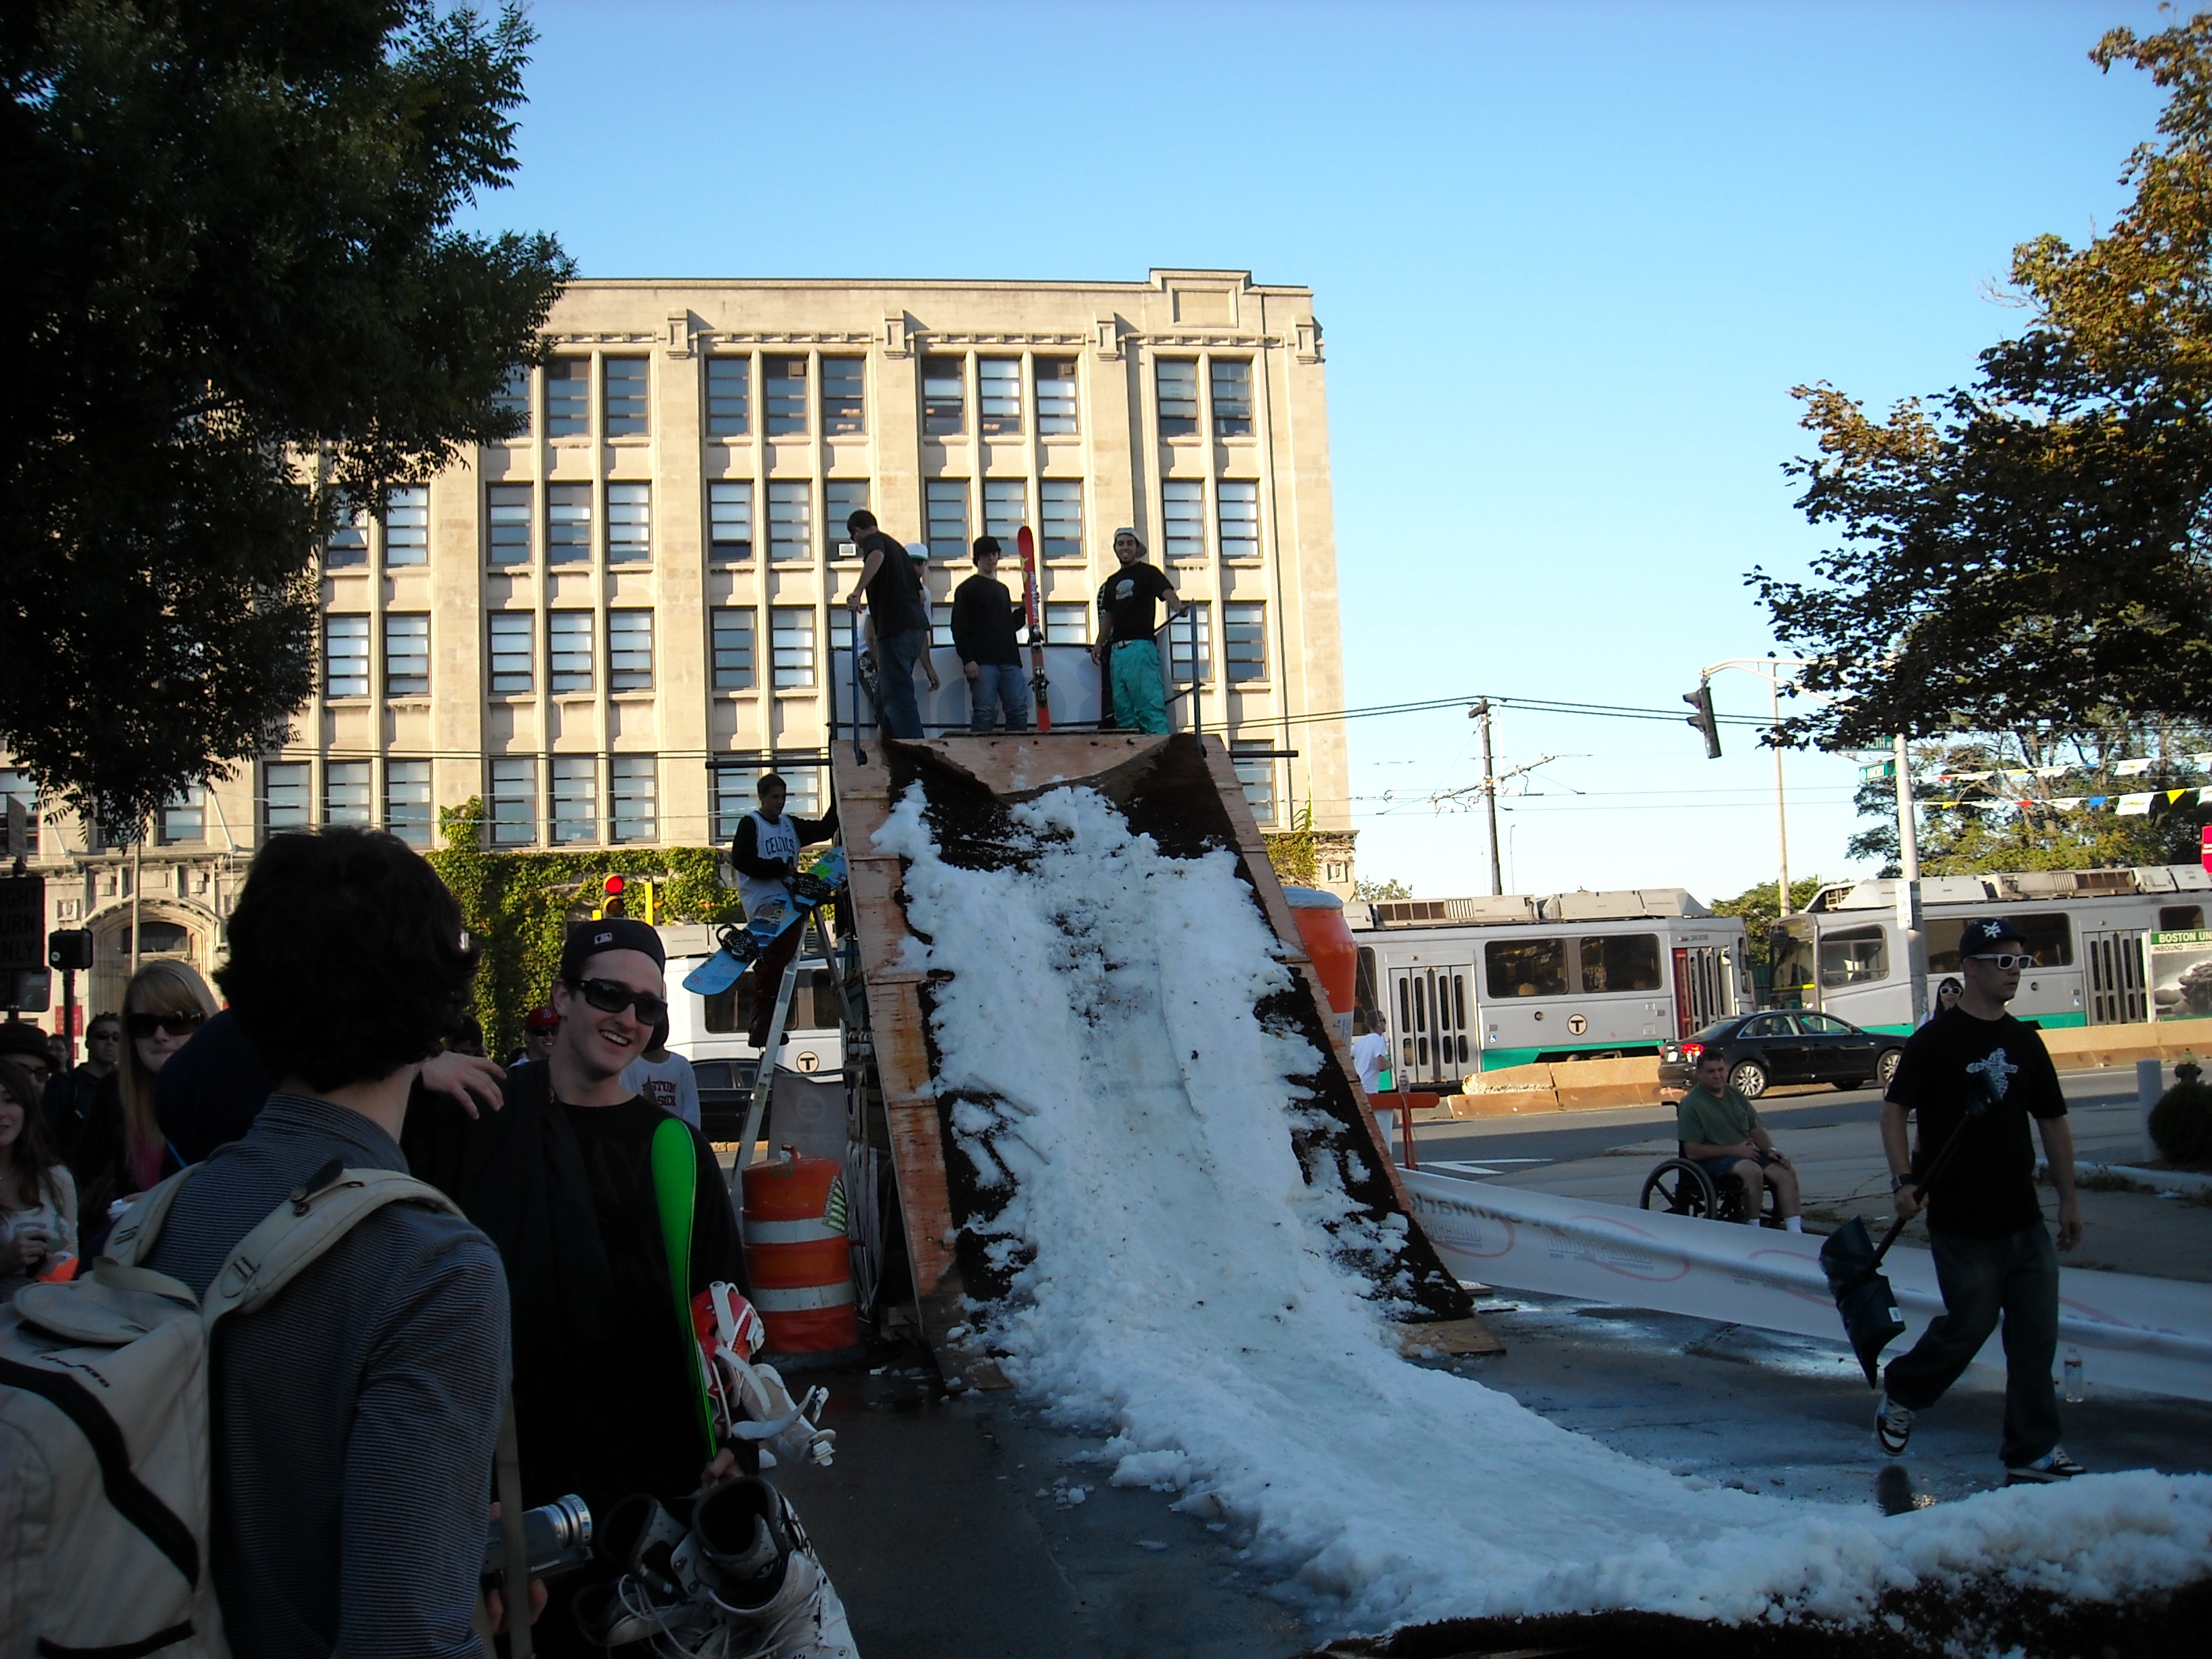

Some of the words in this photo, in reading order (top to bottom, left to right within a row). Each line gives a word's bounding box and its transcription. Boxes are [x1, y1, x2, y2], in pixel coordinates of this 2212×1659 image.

[765, 836, 795, 855] CELTICS
[2158, 931, 2196, 943] BOSTON
[2154, 944, 2184, 952] INBOUND
[1570, 1020, 1584, 1032] T
[800, 1057, 815, 1071] T
[642, 1081, 676, 1093] STON
[657, 1095, 676, 1107] SOX
